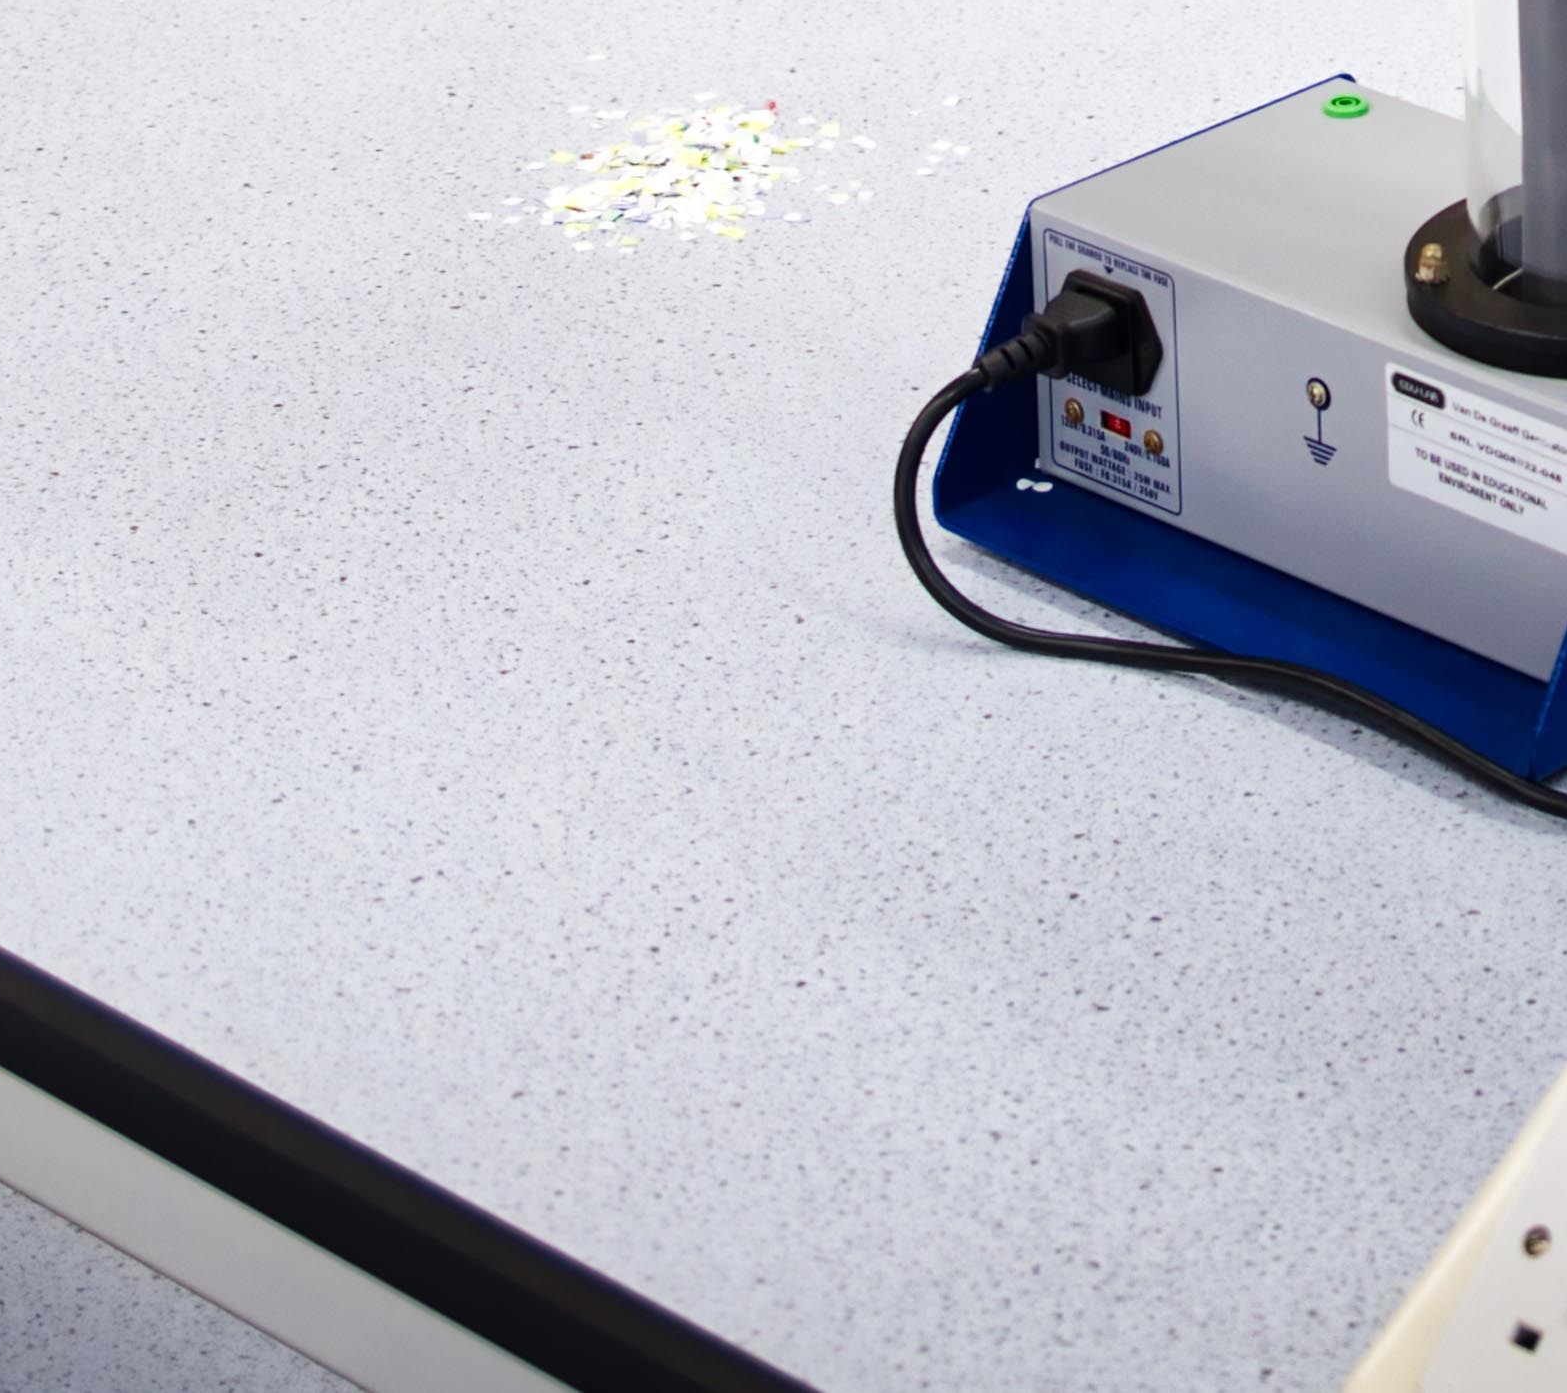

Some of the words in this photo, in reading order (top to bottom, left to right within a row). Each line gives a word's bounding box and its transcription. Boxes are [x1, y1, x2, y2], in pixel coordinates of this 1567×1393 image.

[1113, 257, 1139, 276] REPLACE
[1134, 395, 1163, 419] INPUT
[1452, 401, 1472, 416] Van
[1059, 440, 1089, 460] OUTPUT
[1091, 452, 1127, 476] WATTAGE
[1074, 458, 1093, 473] FUSE
[1415, 446, 1428, 461] TO
[1430, 452, 1442, 467] BE
[1444, 459, 1470, 477] USED
[1471, 469, 1481, 481] IN
[1482, 475, 1548, 511] EDUCATIONAL
[1438, 471, 1498, 504] ENVIROMENT
[1499, 496, 1525, 516] ONLY
